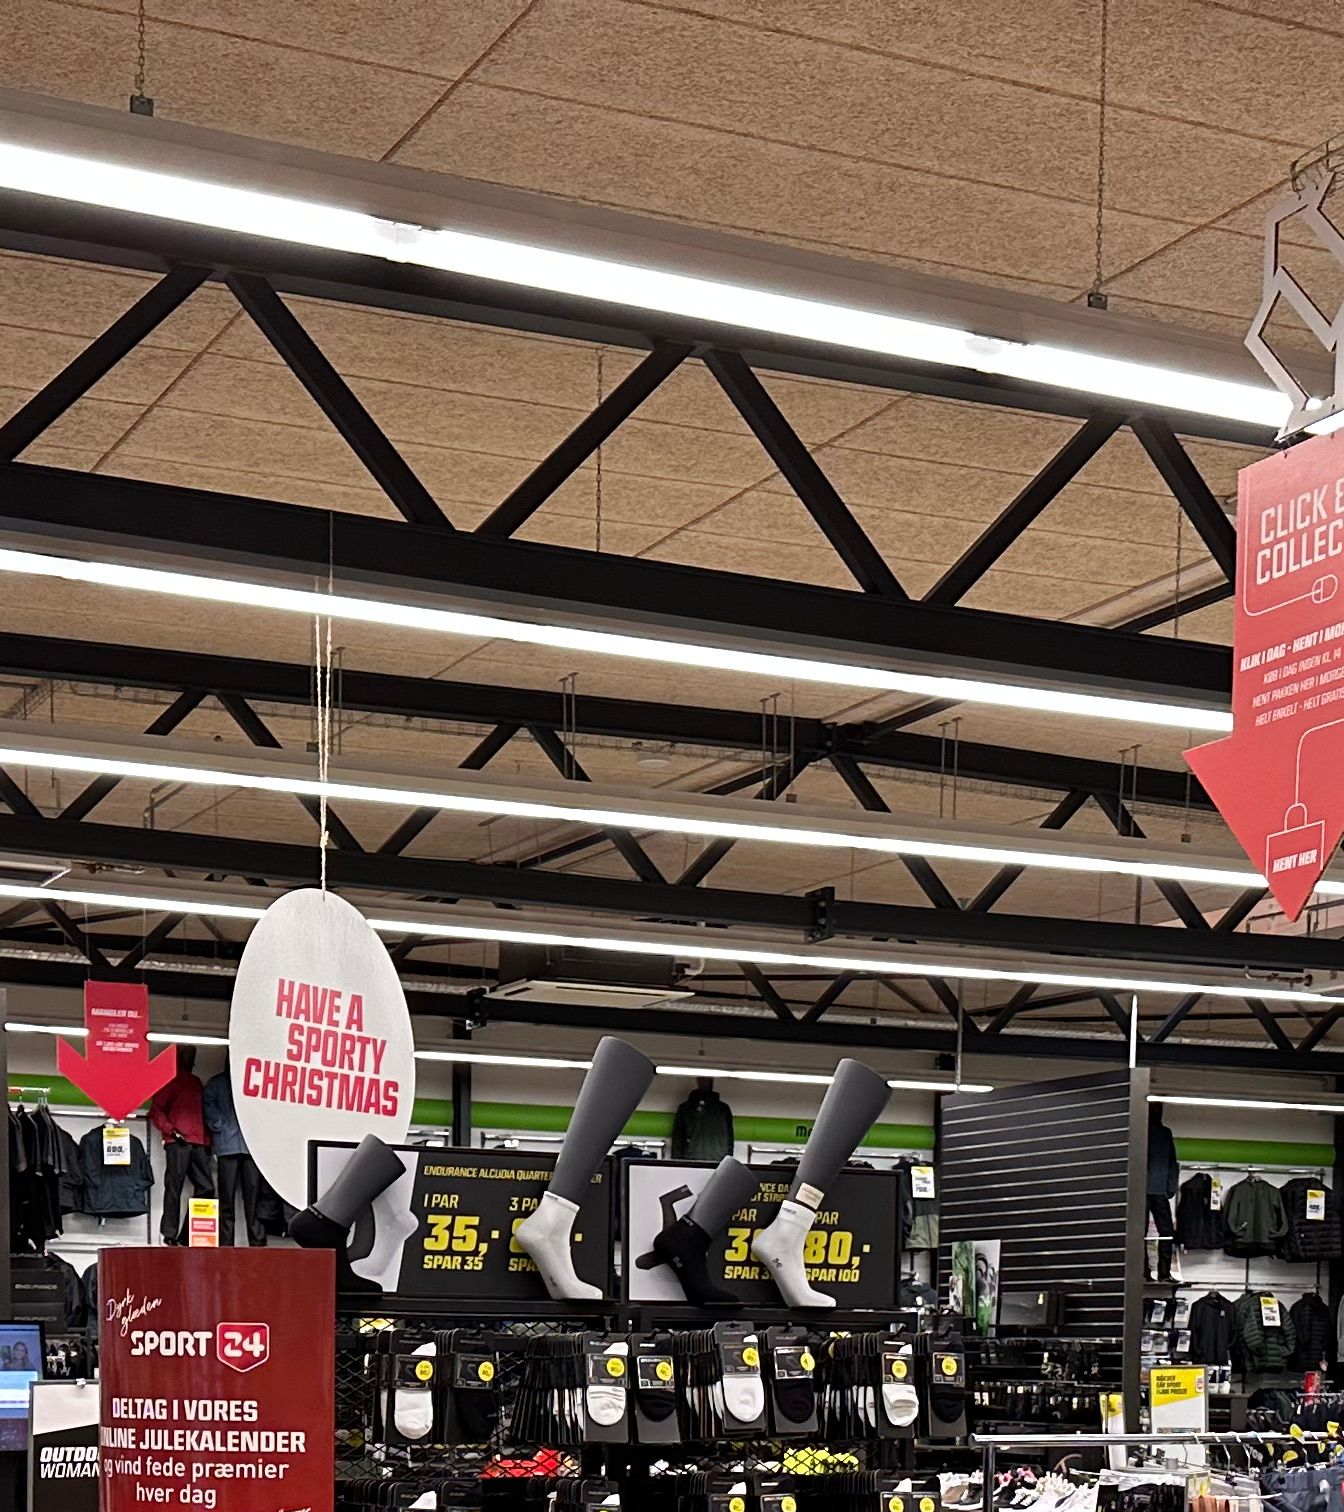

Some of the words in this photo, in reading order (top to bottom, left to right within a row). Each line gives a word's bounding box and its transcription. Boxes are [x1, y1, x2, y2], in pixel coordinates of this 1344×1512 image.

[1260, 484, 1328, 545] CLICK
[1240, 652, 1261, 672] KLIK
[1266, 643, 1287, 663] DAG
[1293, 631, 1319, 653] HENT
[1272, 853, 1298, 873] HENT
[1298, 849, 1317, 867] HER
[276, 978, 342, 1028] HAVE
[345, 994, 363, 1032] A
[287, 1023, 387, 1075] SPORTY
[243, 1057, 399, 1117] CHRISTMAS
[423, 1165, 477, 1179] ENDURANCE
[478, 1168, 515, 1180] ALCUDIA
[516, 1170, 553, 1182] QUARTE
[431, 1194, 459, 1208] PAR
[509, 1197, 518, 1211] 3
[522, 1198, 540, 1211] PA
[815, 1211, 839, 1225] PAR
[423, 1255, 462, 1270] SPAR
[464, 1256, 484, 1270] 35
[508, 1257, 538, 1272] SPA
[724, 1266, 759, 1280] SPAR
[806, 1268, 837, 1282] SPAR
[838, 1269, 859, 1282] 100
[120, 1296, 162, 1337] glæden
[131, 1330, 213, 1357] SPORT
[223, 1331, 265, 1358] 24
[113, 1398, 167, 1420] DELTAG
[172, 1399, 179, 1420] I
[184, 1400, 258, 1422] VORES
[140, 1429, 306, 1453] JULEKALENDER
[40, 1447, 99, 1462] OUTDO
[115, 1455, 141, 1476] vind
[146, 1456, 186, 1477] fede
[192, 1458, 290, 1482] præmier
[136, 1482, 174, 1503] hver
[179, 1484, 217, 1509] dag
